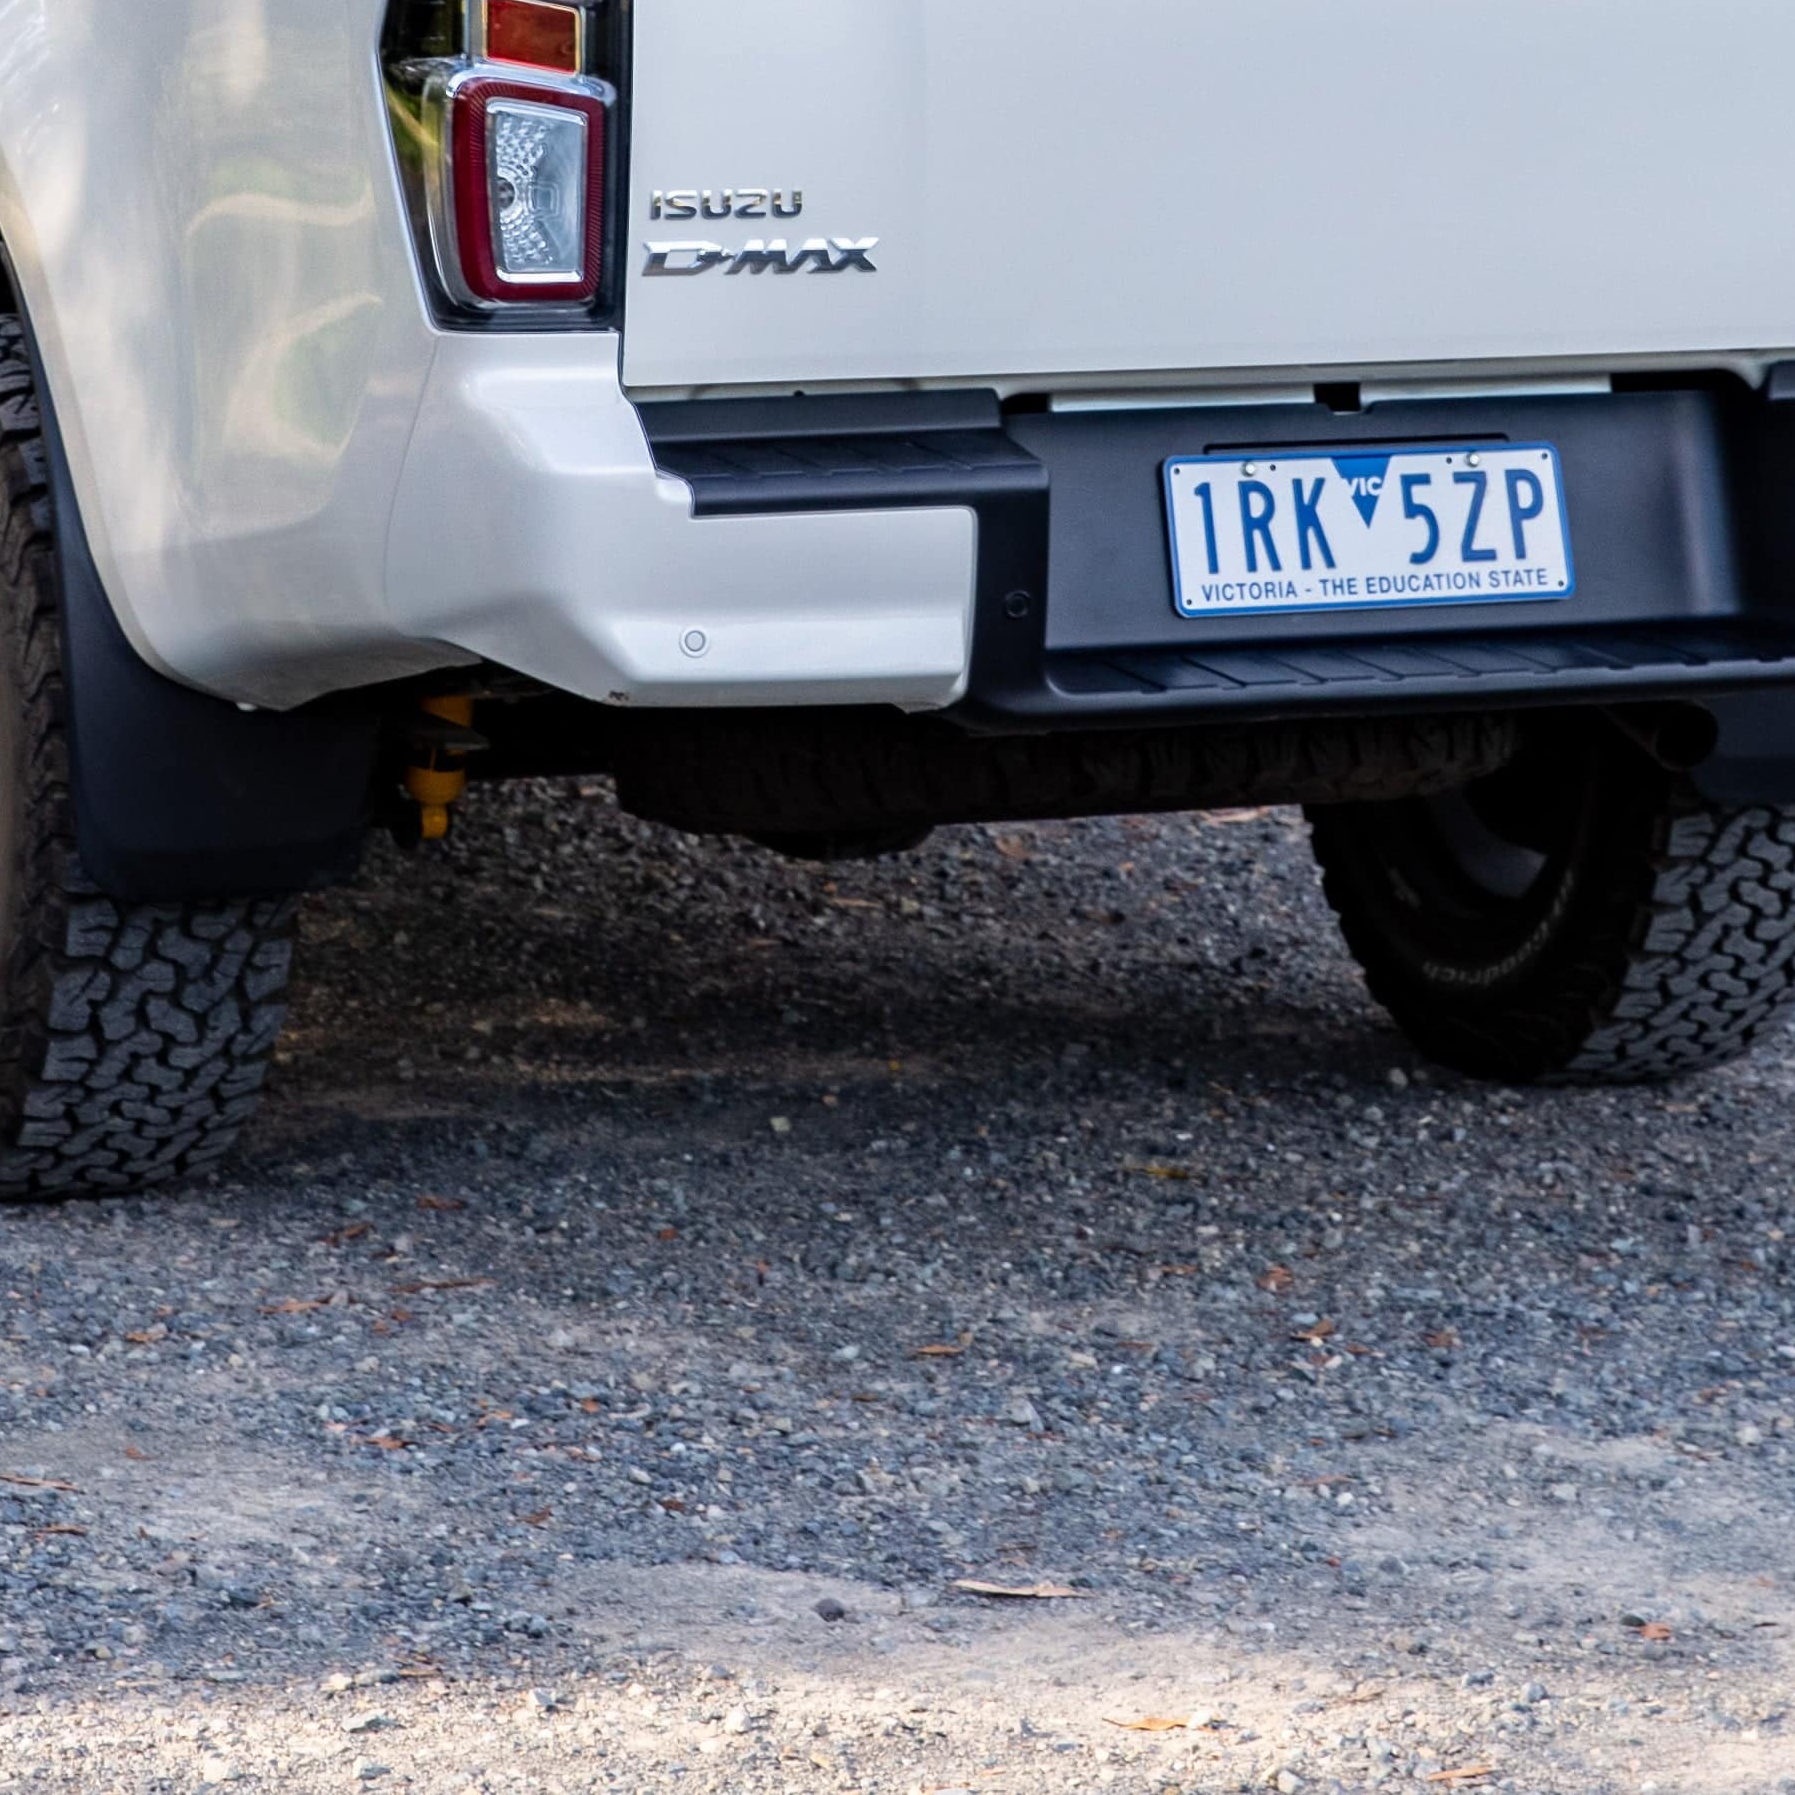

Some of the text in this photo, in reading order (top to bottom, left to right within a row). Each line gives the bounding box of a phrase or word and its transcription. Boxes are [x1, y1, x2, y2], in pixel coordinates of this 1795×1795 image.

[650, 189, 803, 220] ISUZU
[641, 237, 880, 277] D-MAX
[1341, 476, 1384, 497] VIC
[1193, 468, 1545, 575] 1RK 5ZP
[1202, 580, 1298, 602] VICTORIA
[1319, 577, 1359, 597] THE
[1366, 572, 1482, 595] EDUCATION
[1488, 567, 1549, 588] STATE
